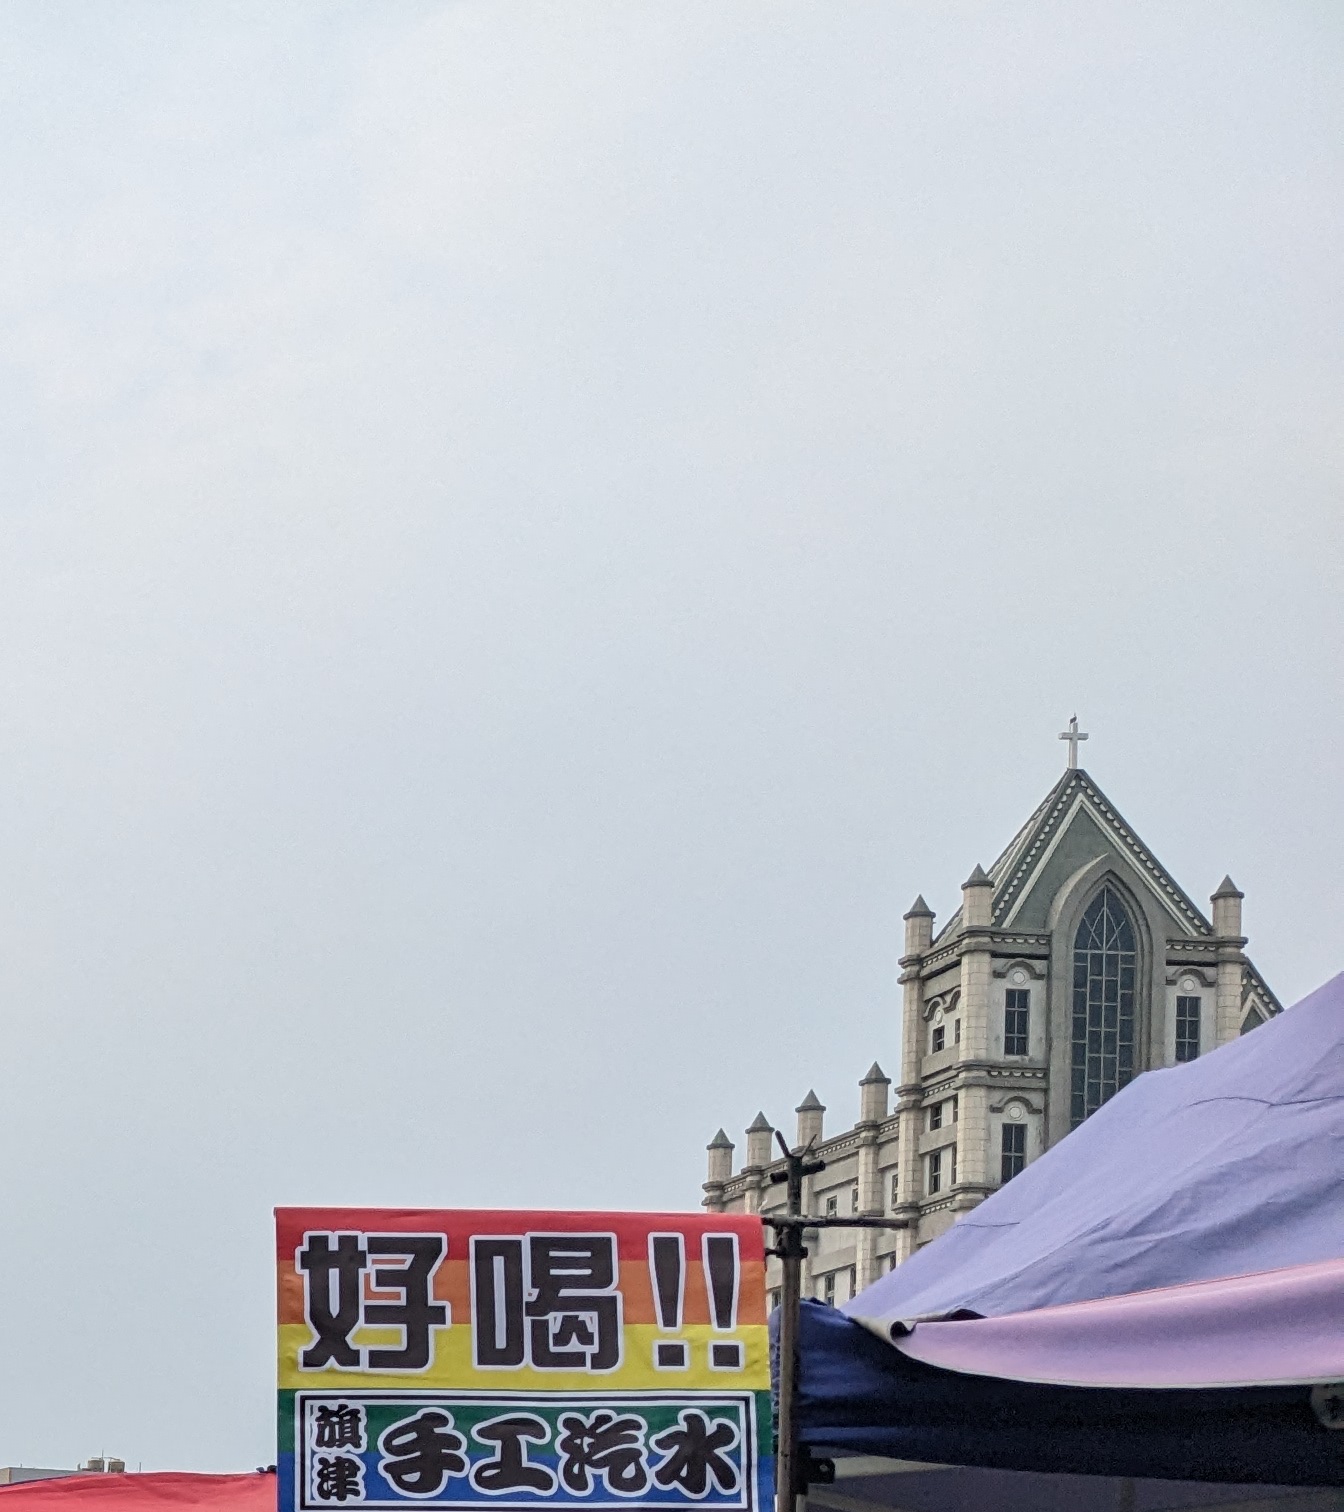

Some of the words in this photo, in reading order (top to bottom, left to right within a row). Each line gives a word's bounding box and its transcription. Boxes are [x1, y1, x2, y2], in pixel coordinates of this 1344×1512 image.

[315, 1404, 362, 1501] 旗津
[383, 1412, 737, 1494] 手工汽水
